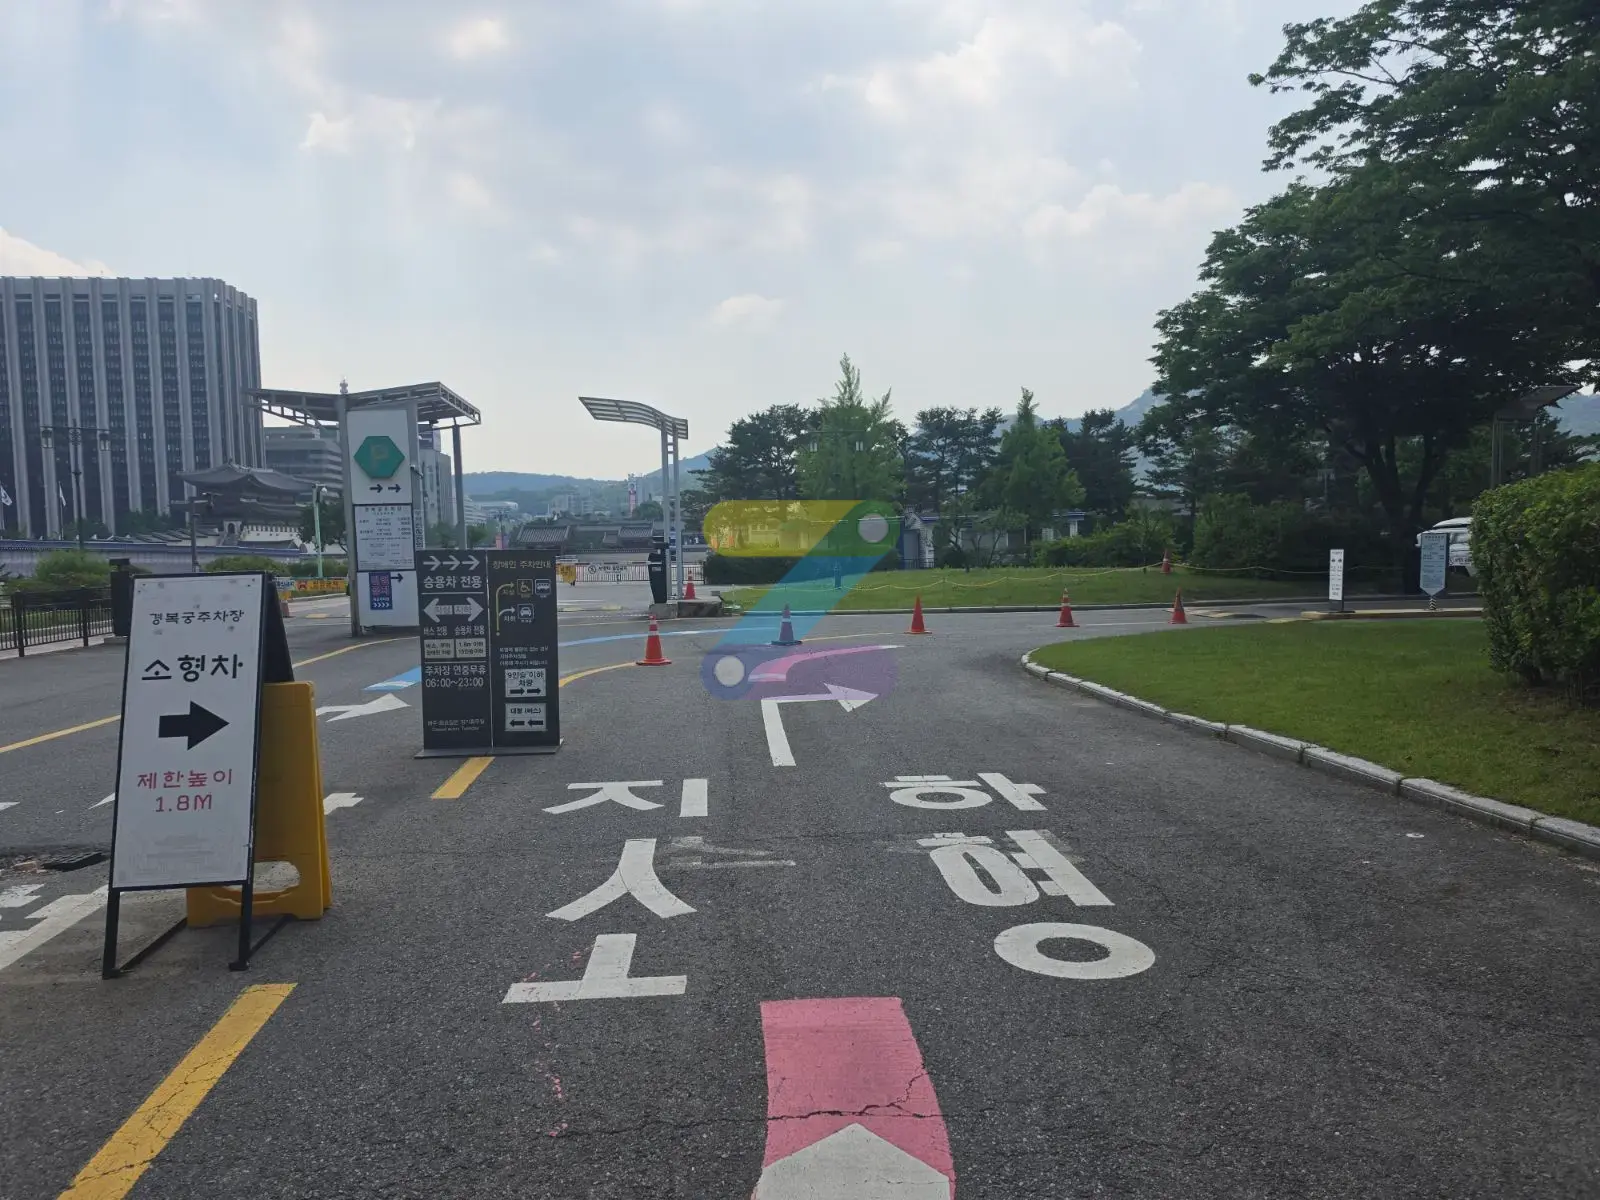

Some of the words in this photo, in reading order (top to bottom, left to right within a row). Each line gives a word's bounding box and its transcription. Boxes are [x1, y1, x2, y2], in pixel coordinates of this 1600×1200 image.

[493, 560, 517, 570] 장애인
[519, 559, 552, 569] 주차안내
[423, 576, 457, 589] 승용차
[460, 575, 482, 588] 전용
[149, 610, 245, 625] 경복궁주차장
[423, 625, 435, 635] 버스
[454, 624, 472, 636] 승용차
[473, 624, 485, 635] 전용
[141, 654, 243, 682] 소형차
[425, 665, 452, 676] 주차장
[453, 664, 487, 676] 연중무휴
[529, 670, 544, 679] 이하
[425, 677, 484, 688] 06:00~23:00
[518, 679, 533, 687] 차량
[137, 768, 233, 789] 제한높이
[154, 794, 213, 812] 1.8M
